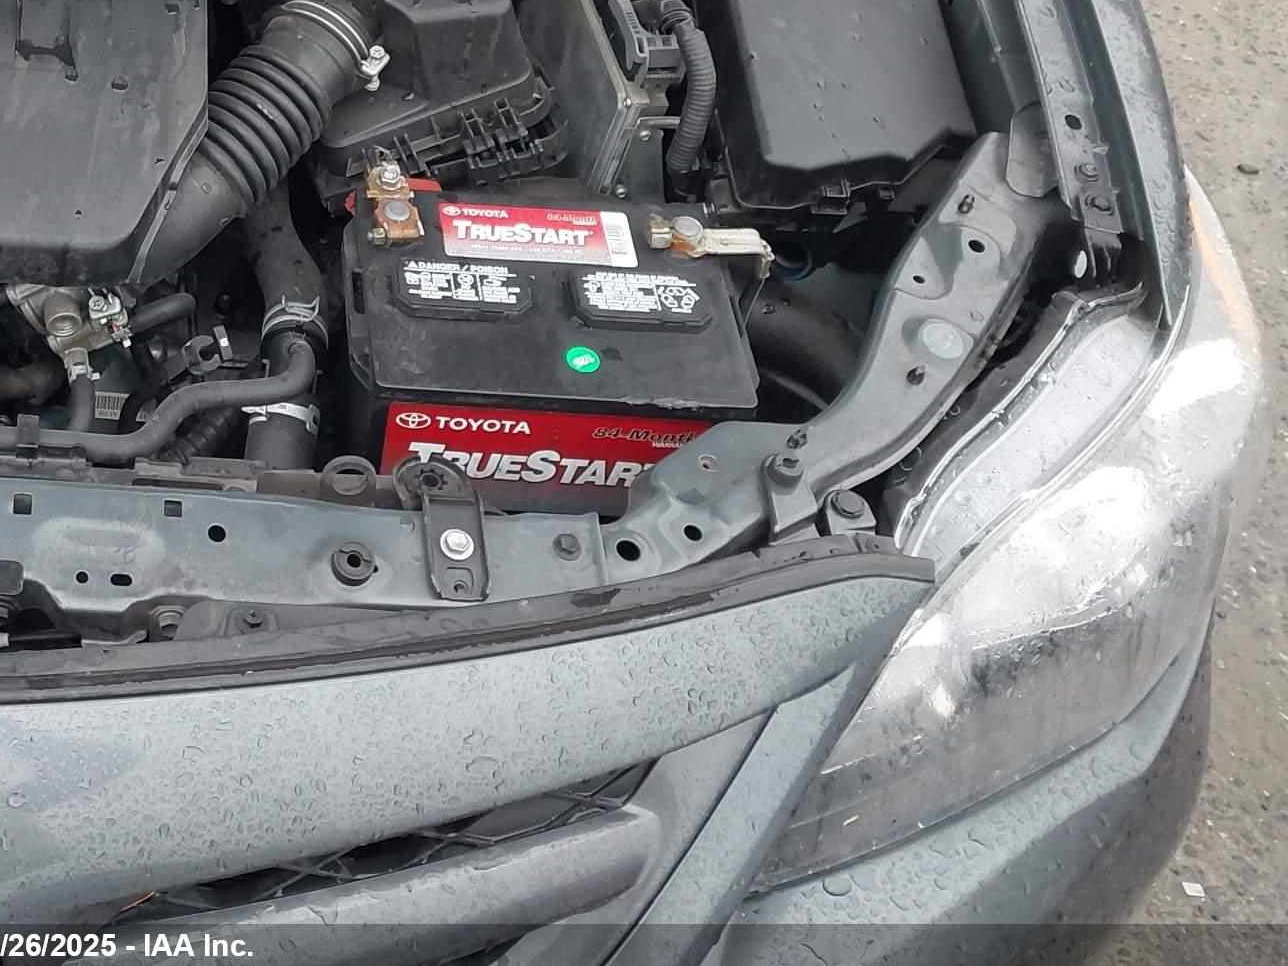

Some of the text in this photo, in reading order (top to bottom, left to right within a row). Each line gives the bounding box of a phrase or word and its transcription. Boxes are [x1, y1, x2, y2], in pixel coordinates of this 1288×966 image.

[462, 208, 509, 219] TOYOTA
[418, 261, 460, 271] DANGER
[470, 265, 509, 274] POISON
[435, 416, 531, 435] TOYOTA
[408, 441, 653, 488] TRUESTAR
